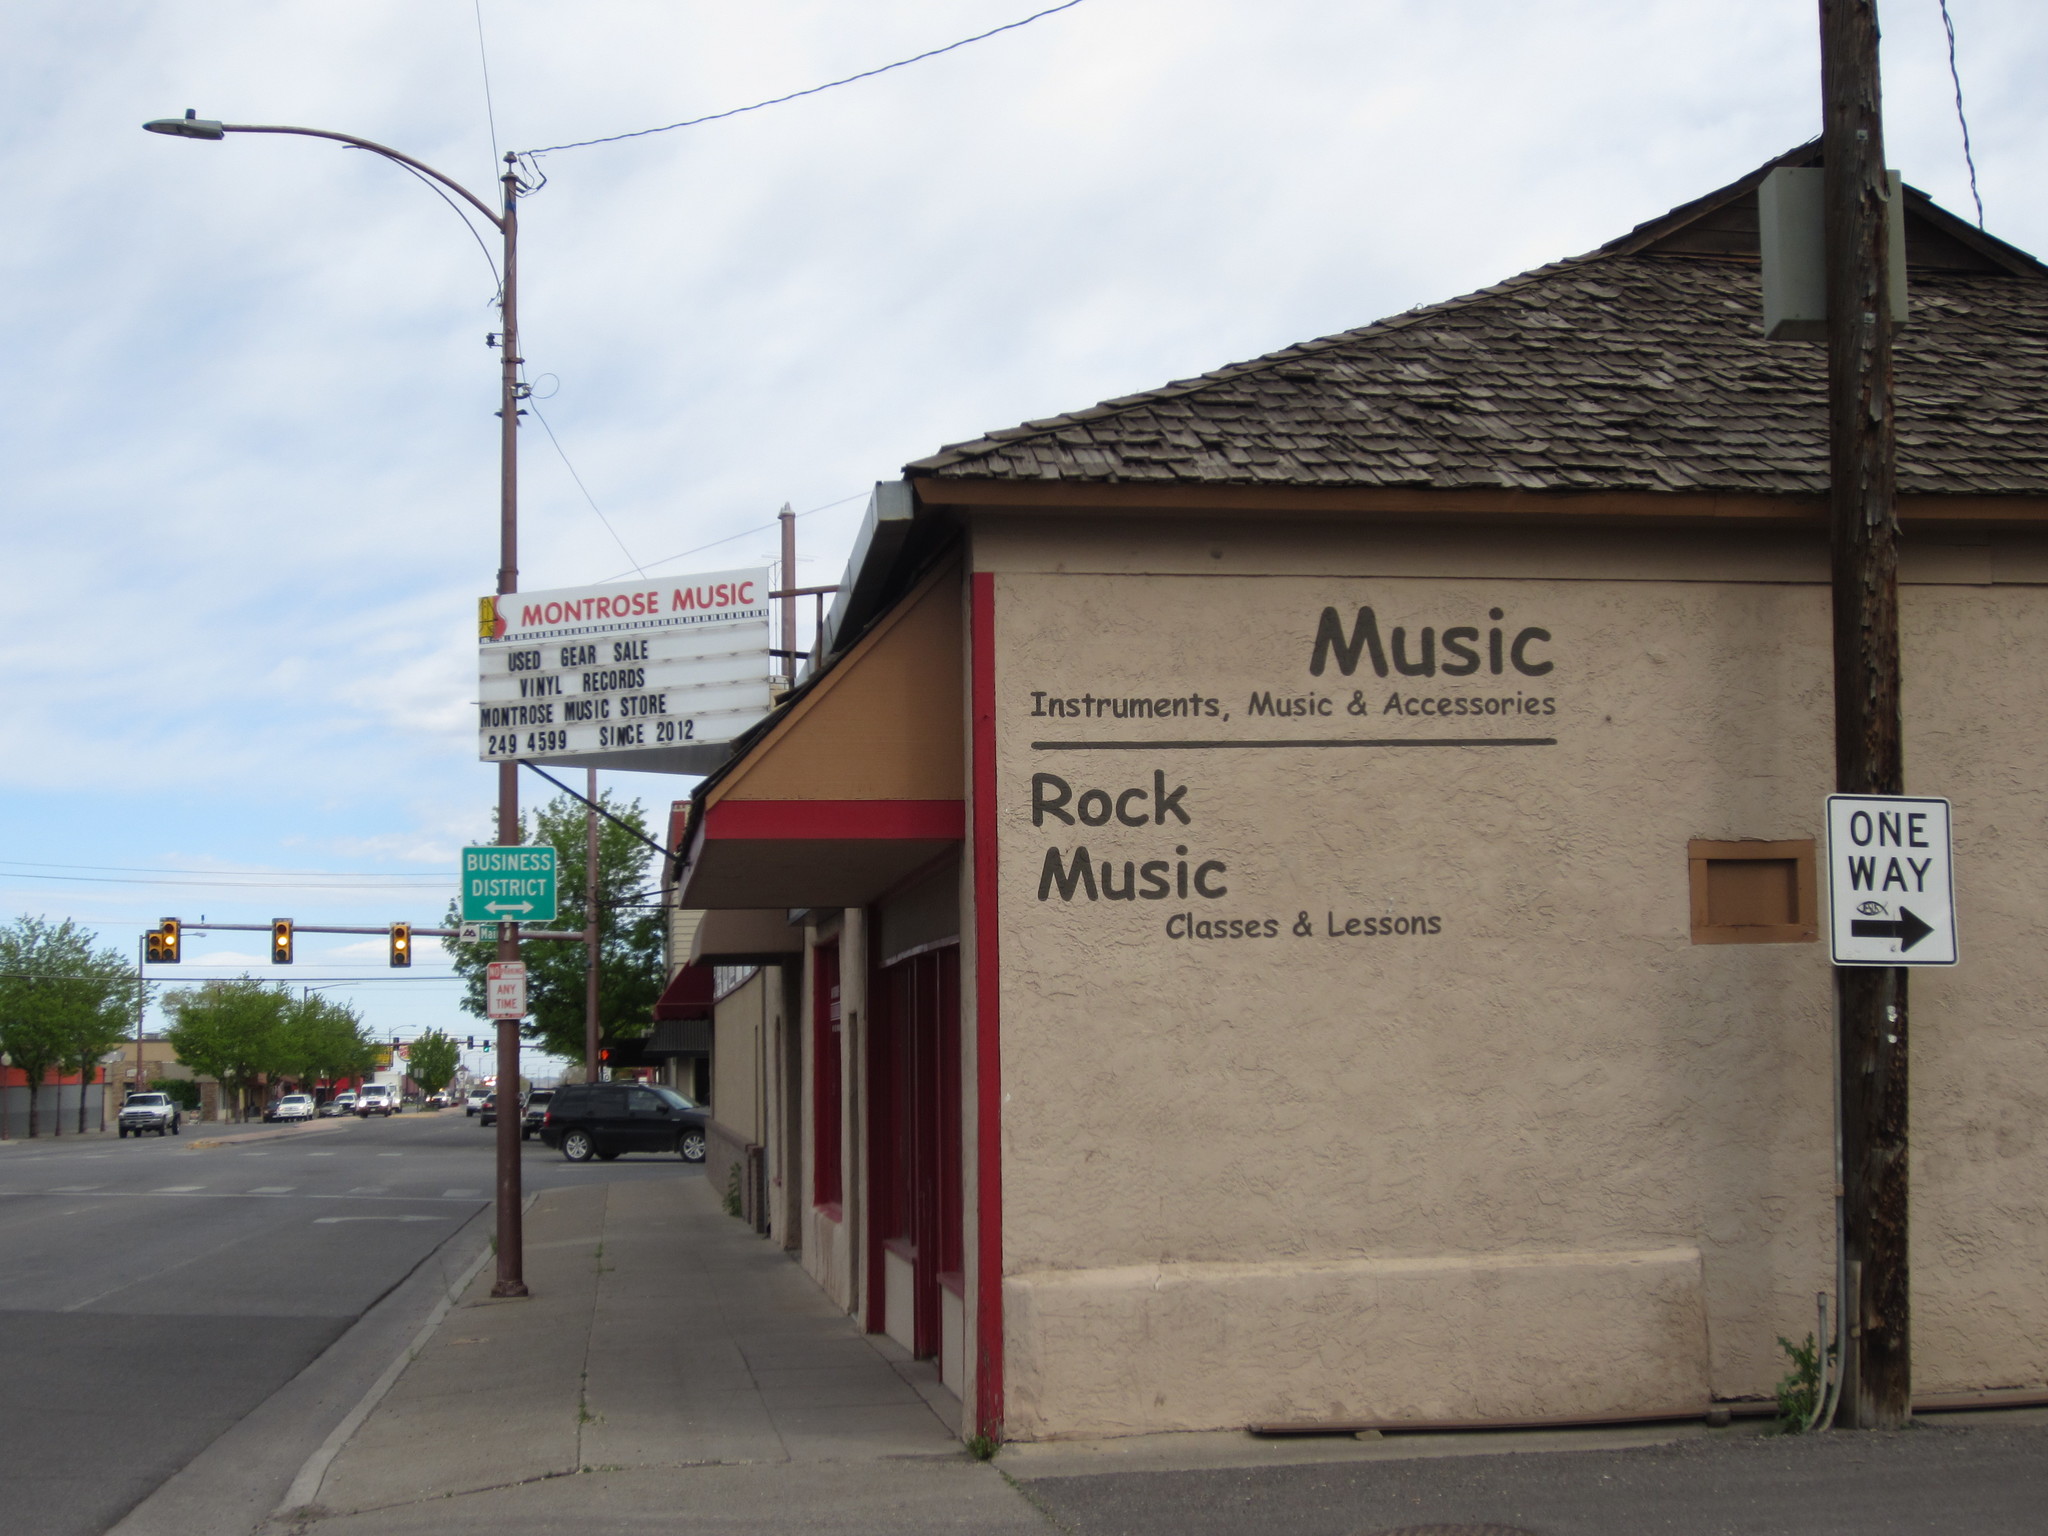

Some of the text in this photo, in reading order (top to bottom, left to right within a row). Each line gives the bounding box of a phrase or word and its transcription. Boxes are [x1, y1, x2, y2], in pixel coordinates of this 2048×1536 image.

[521, 581, 754, 627] MONTROSE MUSIC
[508, 640, 649, 672] USED GEAR SALE
[1309, 604, 1555, 679] Music
[520, 668, 645, 698] VINYL RECORDS
[481, 694, 666, 728] MONTROSE MUSIC STORE
[1030, 690, 1556, 722] Instruments, Music & Accessories
[488, 719, 694, 755] 249 4599 SINCE 2012
[1031, 769, 1192, 827] Rock
[1850, 810, 1929, 848] ONE
[467, 854, 551, 871] BUSINESS
[1037, 845, 1228, 902] Music
[1848, 856, 1932, 892] WAY
[472, 879, 547, 896] DISTRICT
[480, 927, 498, 940] Mai
[1166, 911, 1442, 940] Classes & Lessons
[489, 966, 500, 977] NO
[496, 999, 517, 1009] TIME
[497, 984, 516, 995] ANY
